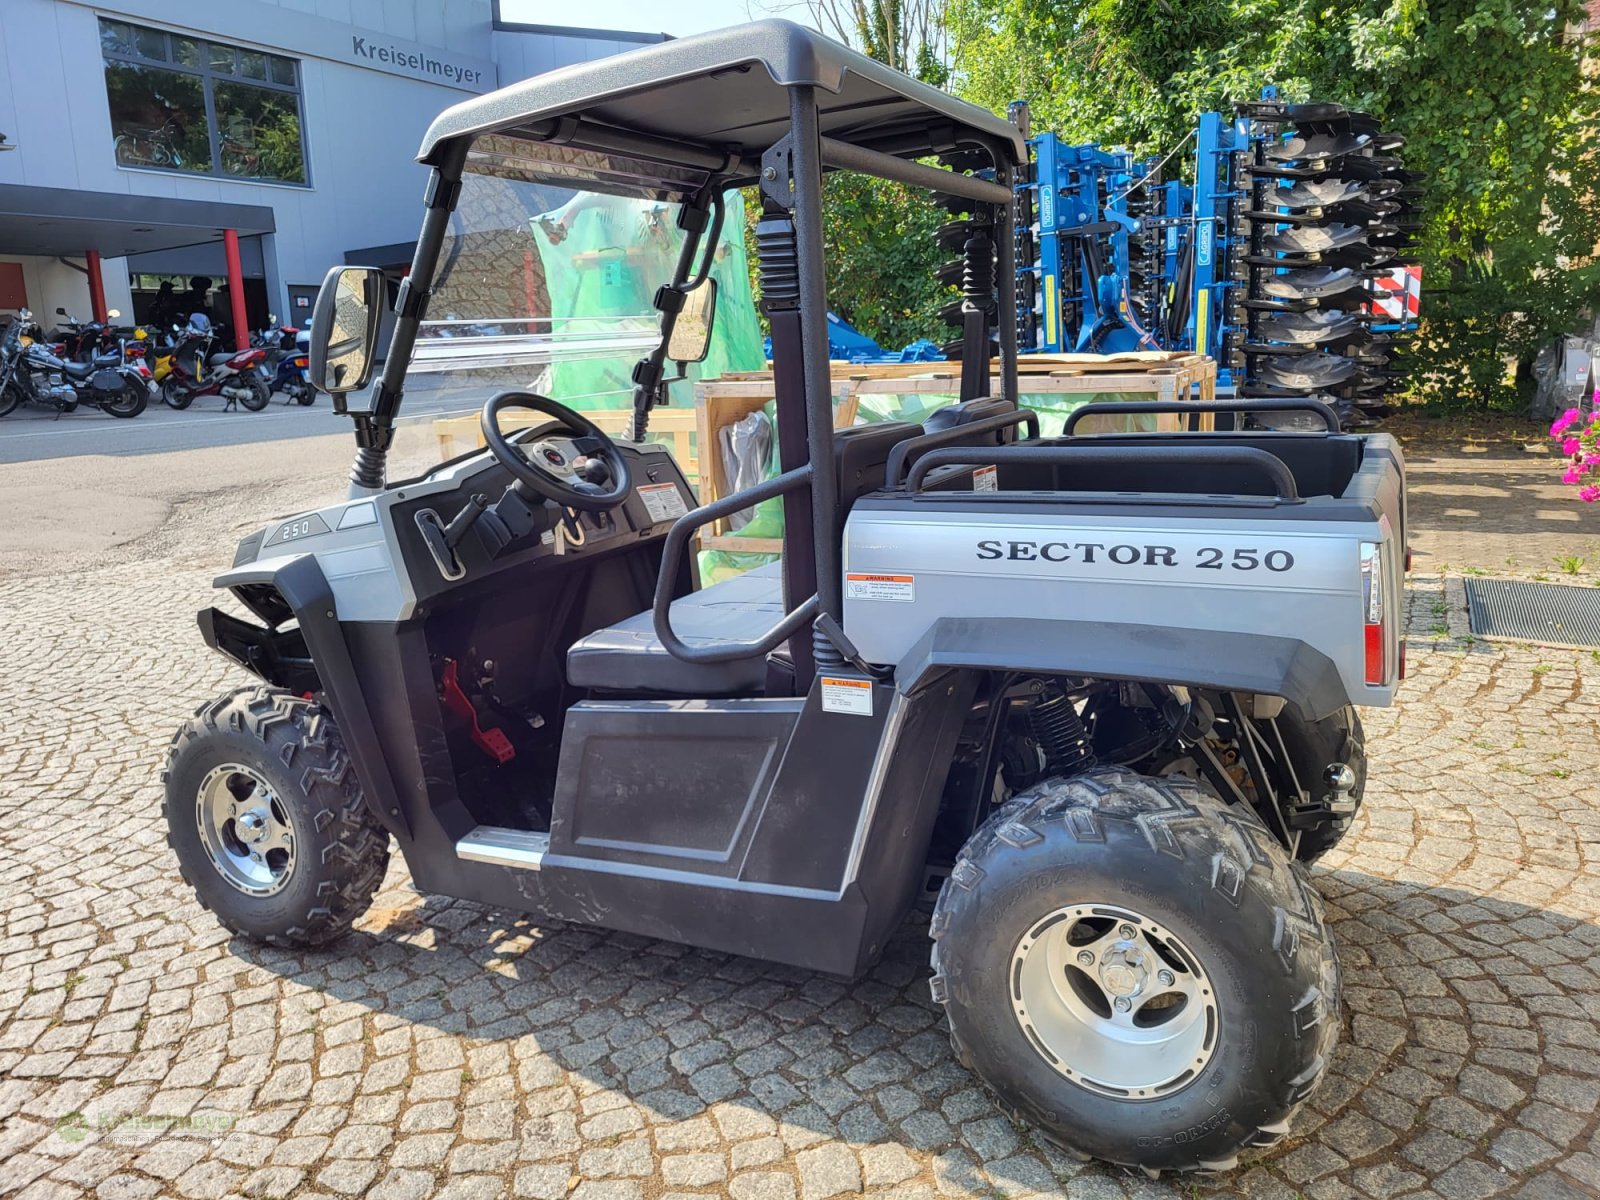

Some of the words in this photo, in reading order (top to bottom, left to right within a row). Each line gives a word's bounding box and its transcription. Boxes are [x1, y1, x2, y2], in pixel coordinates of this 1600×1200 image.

[352, 36, 482, 84] Kreiselmeyer
[1200, 223, 1209, 255] AGRIPOL
[283, 521, 309, 539] 250
[977, 540, 1179, 566] SECTOR
[1195, 547, 1294, 572] 250
